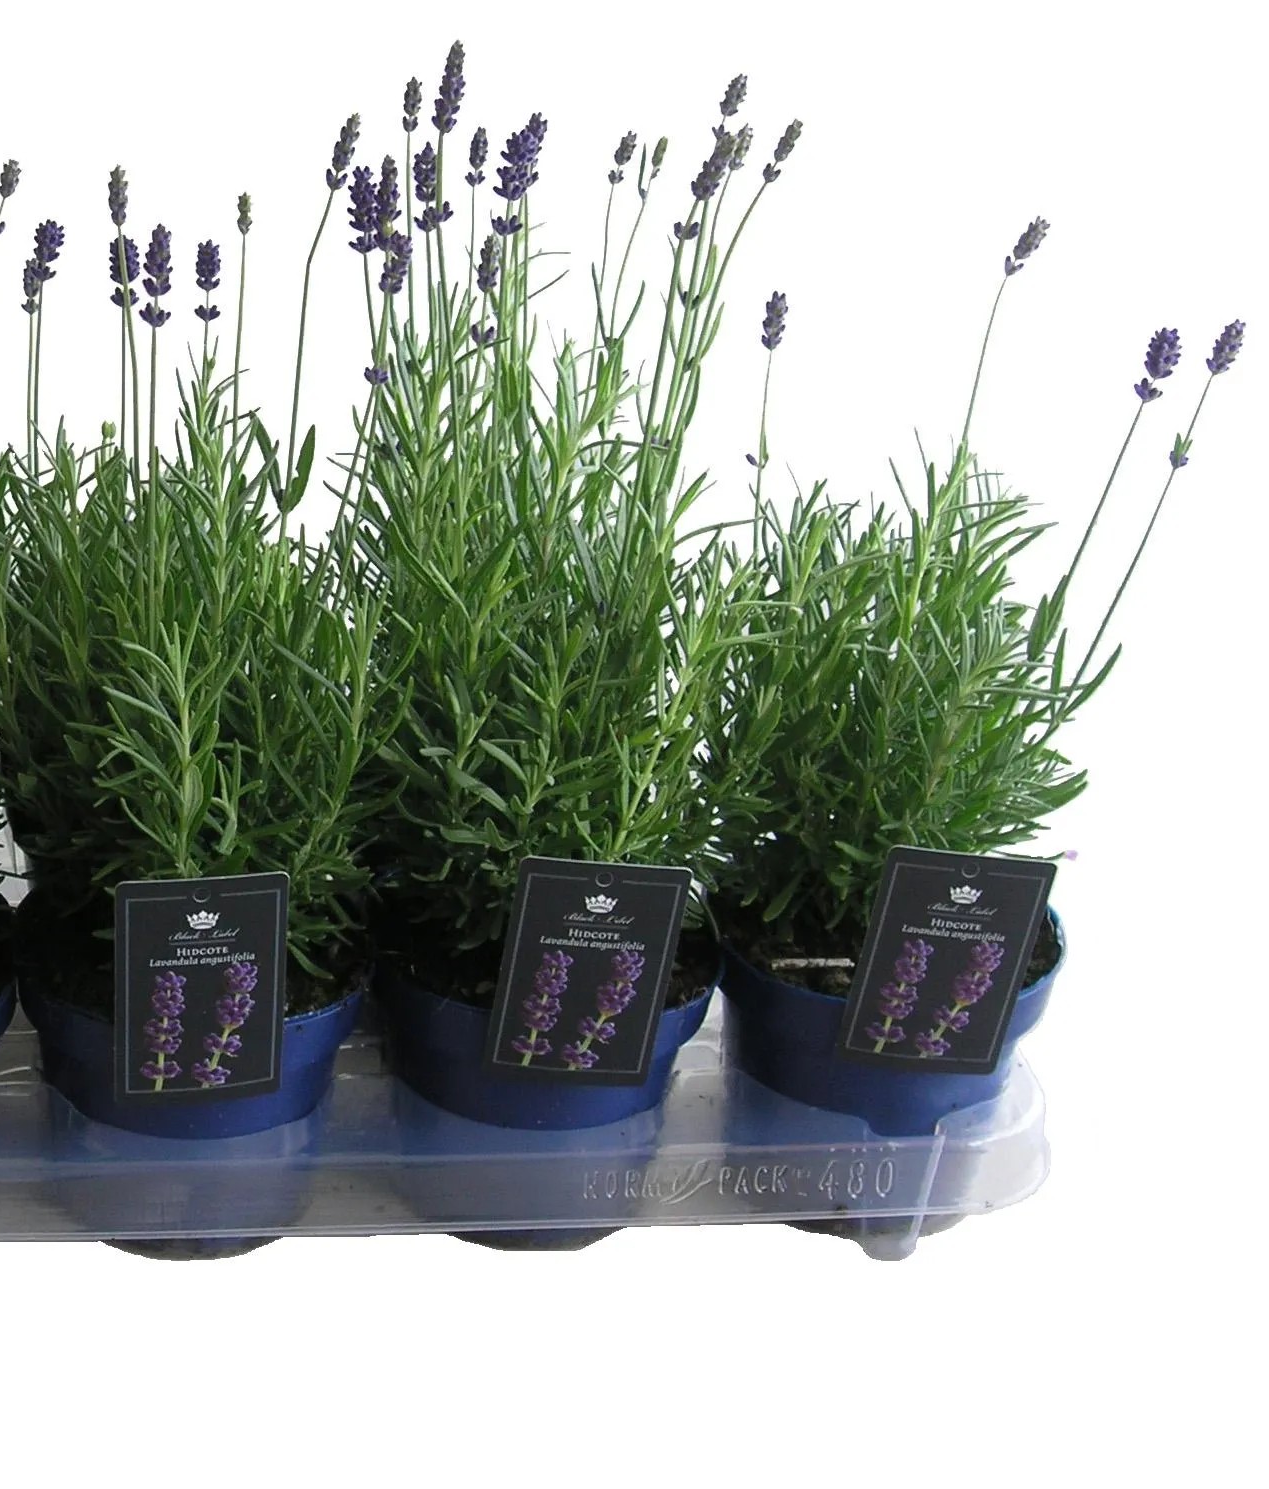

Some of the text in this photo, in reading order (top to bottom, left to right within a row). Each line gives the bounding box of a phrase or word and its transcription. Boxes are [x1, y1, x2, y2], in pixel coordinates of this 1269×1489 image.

[931, 918, 982, 931] HIDCOTE
[568, 928, 620, 940] HIDCOTE
[901, 924, 1005, 942] Lavandula angustifolia
[540, 935, 645, 952] Lavandula angustifolia
[176, 946, 229, 957] HIDCOTE
[149, 952, 255, 967] Lavandula angustifolia
[818, 1157, 894, 1200] 480
